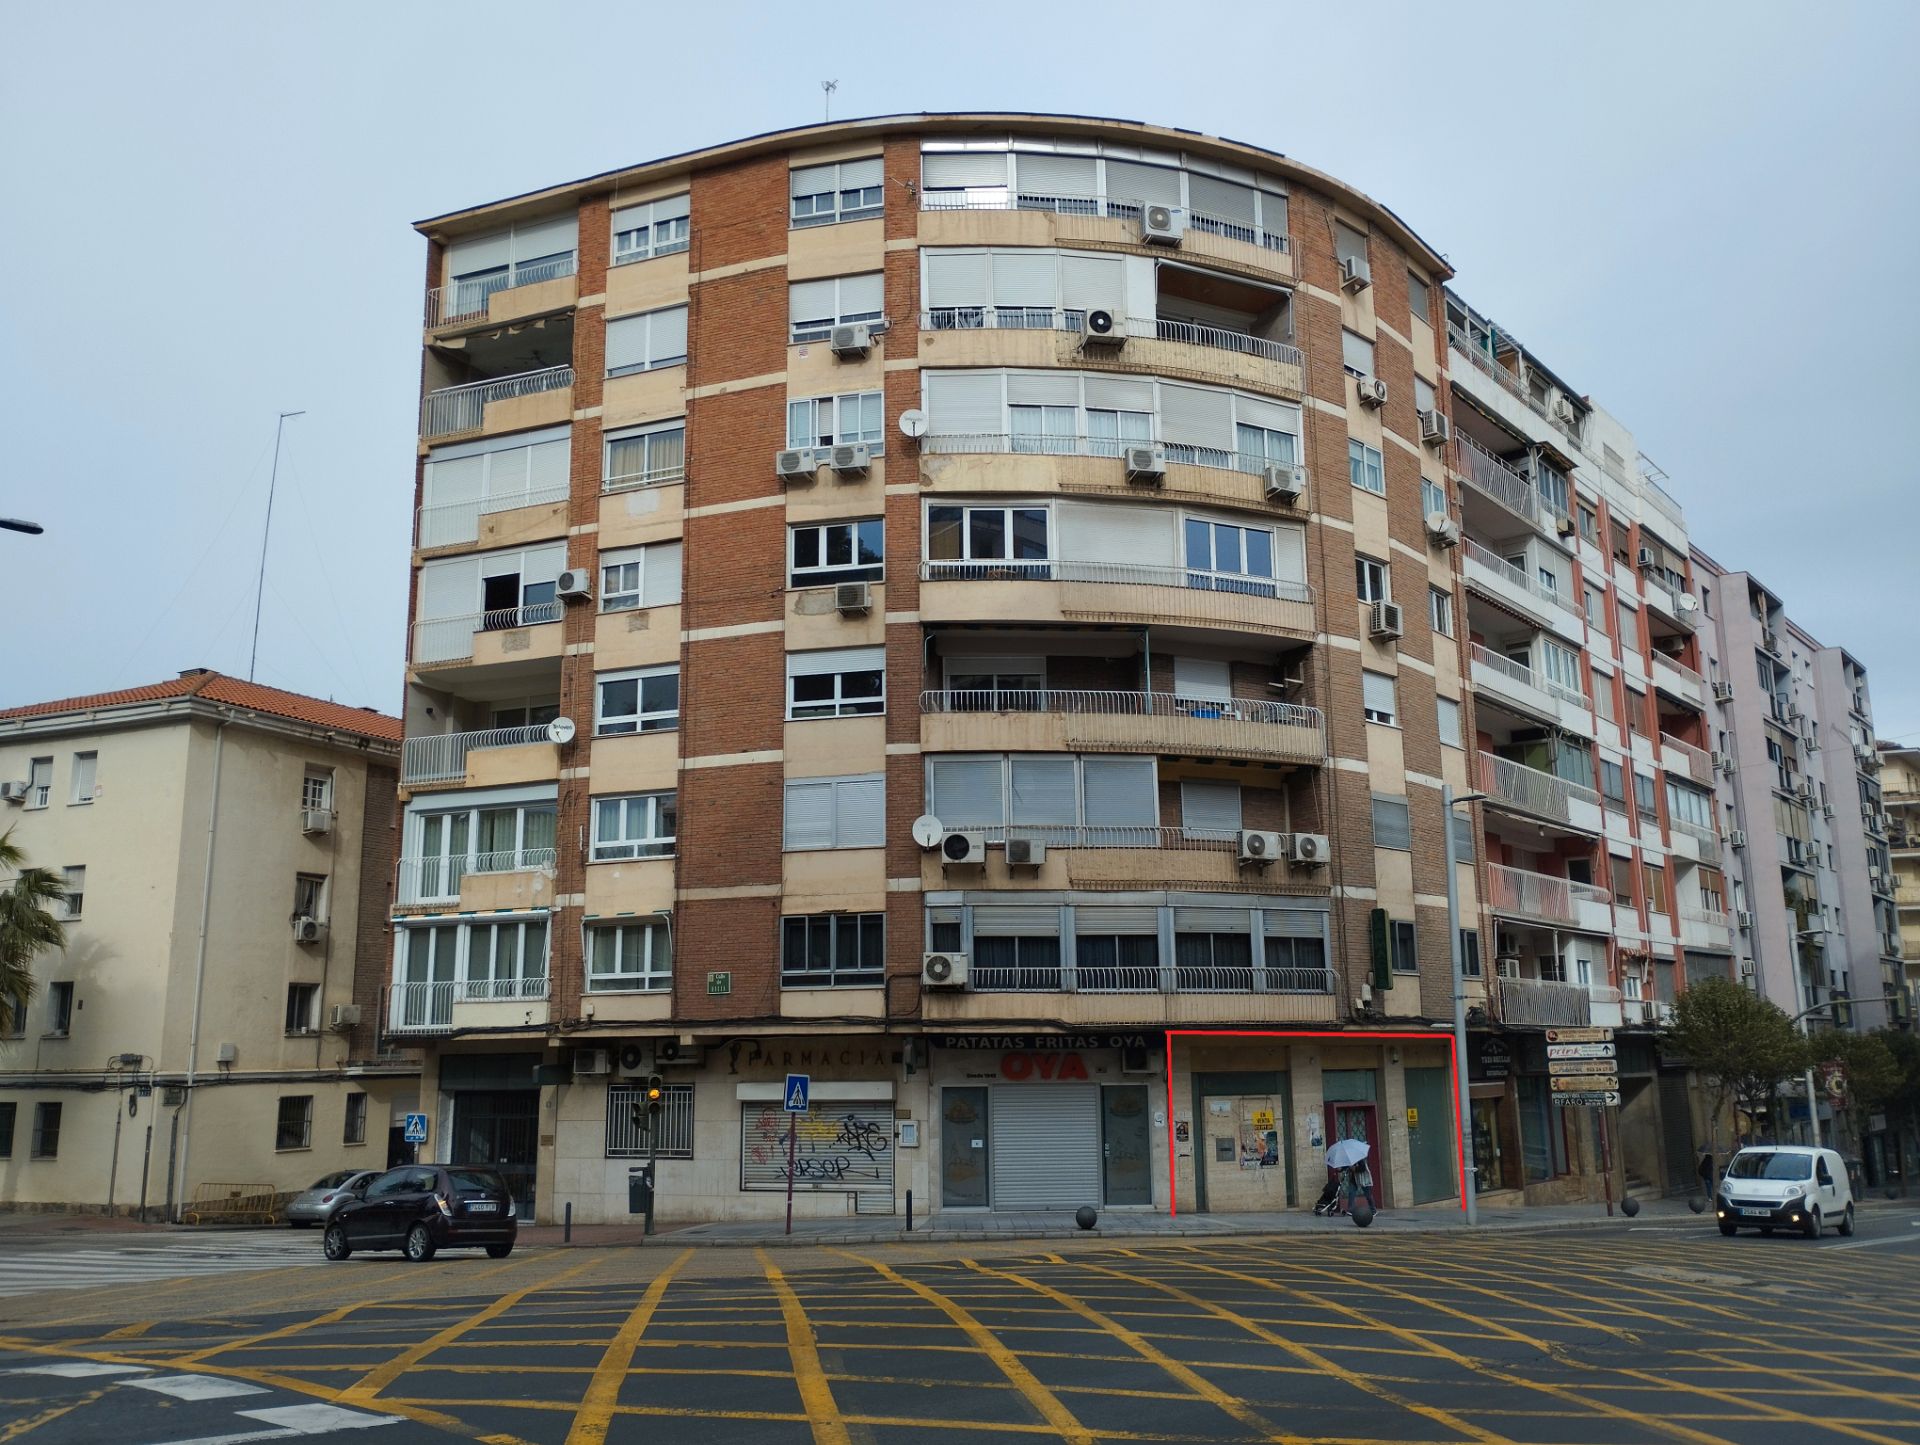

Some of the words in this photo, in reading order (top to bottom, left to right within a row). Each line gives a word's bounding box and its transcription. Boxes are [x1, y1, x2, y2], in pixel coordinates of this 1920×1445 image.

[946, 1036, 1025, 1048] PATATAS
[1035, 1036, 1099, 1048] FRITAS
[1109, 1035, 1146, 1047] OYA
[749, 1050, 884, 1066] FARMACIA
[1002, 1053, 1088, 1080] OYA
